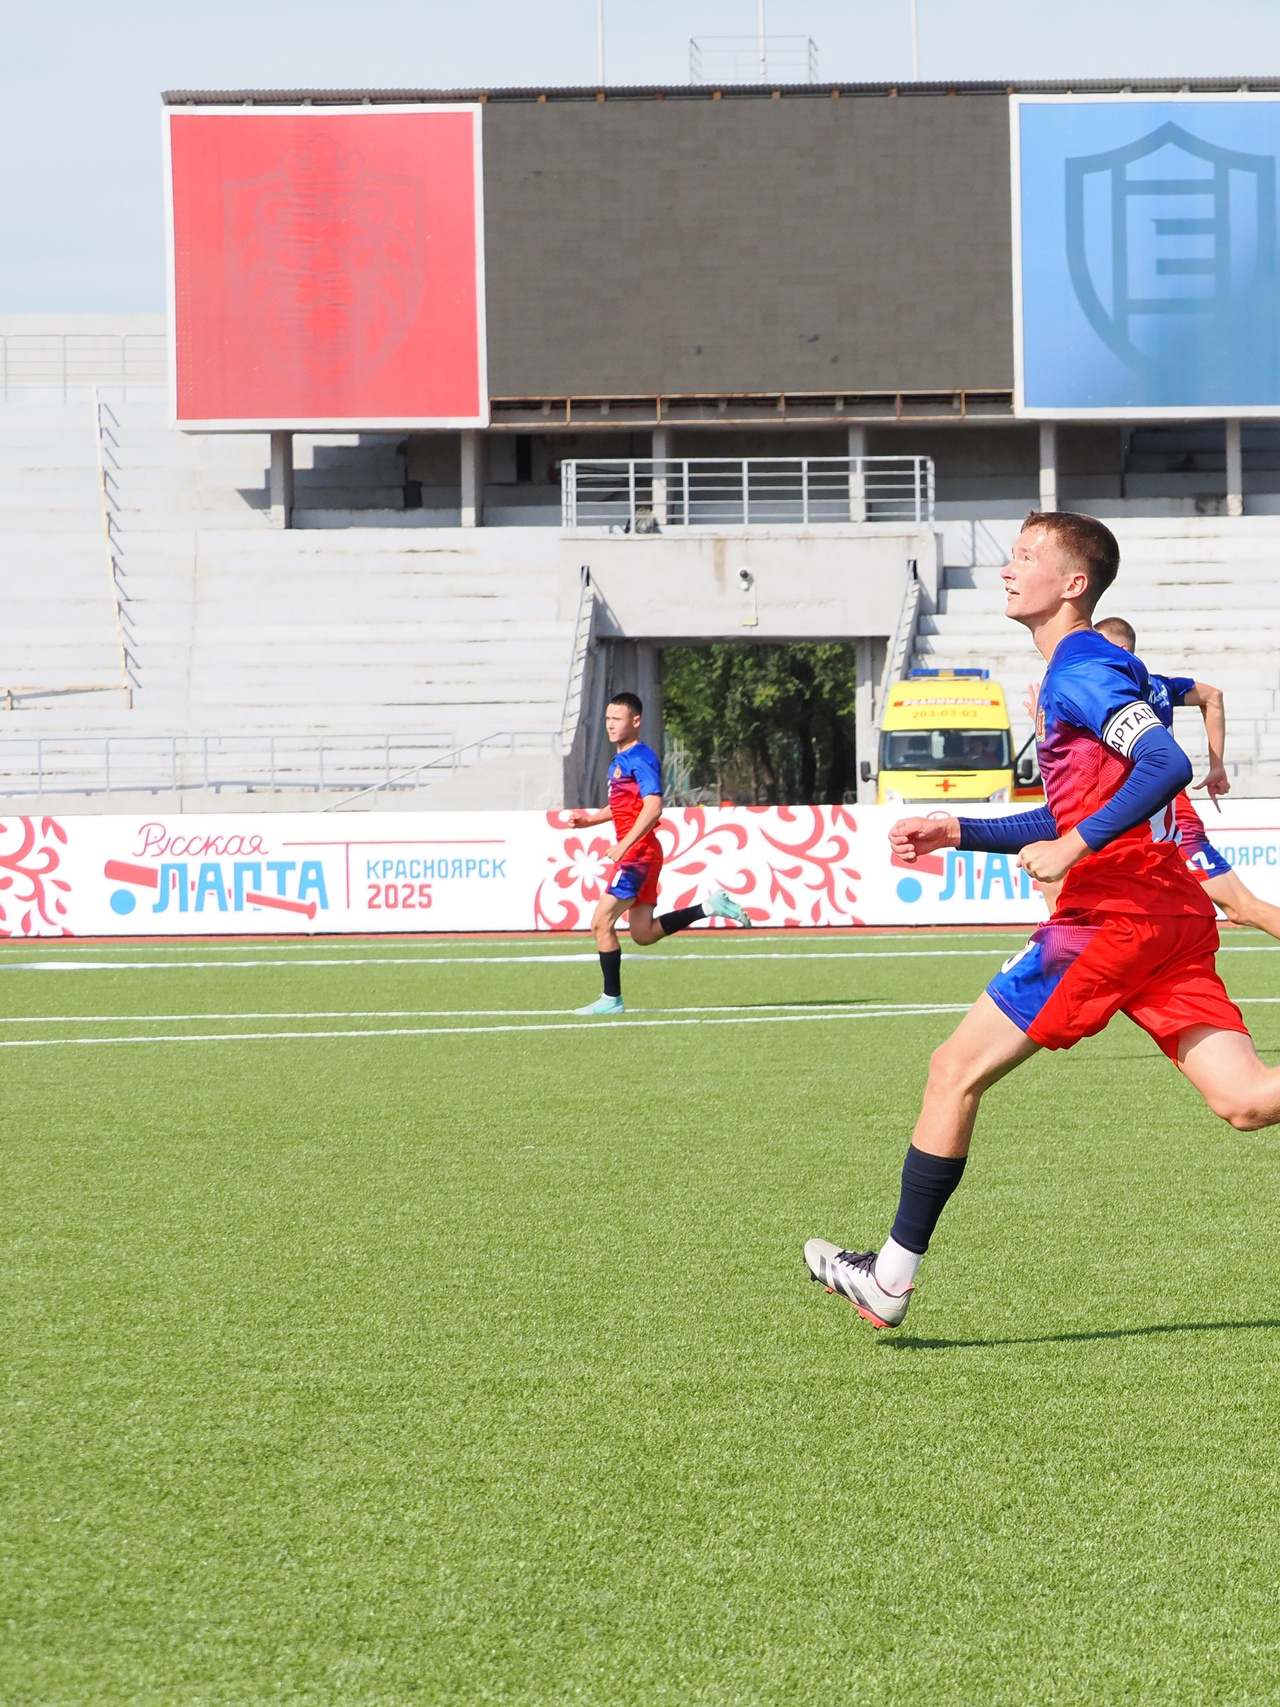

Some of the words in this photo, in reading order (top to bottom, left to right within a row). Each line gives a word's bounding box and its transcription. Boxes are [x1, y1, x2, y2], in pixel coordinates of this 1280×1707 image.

[912, 709, 979, 719] 203-03-03
[132, 822, 271, 858] Русская
[366, 858, 507, 879] КРАСНОЯРСК
[153, 860, 329, 913] ЛАПТА
[367, 884, 432, 909] 2025
